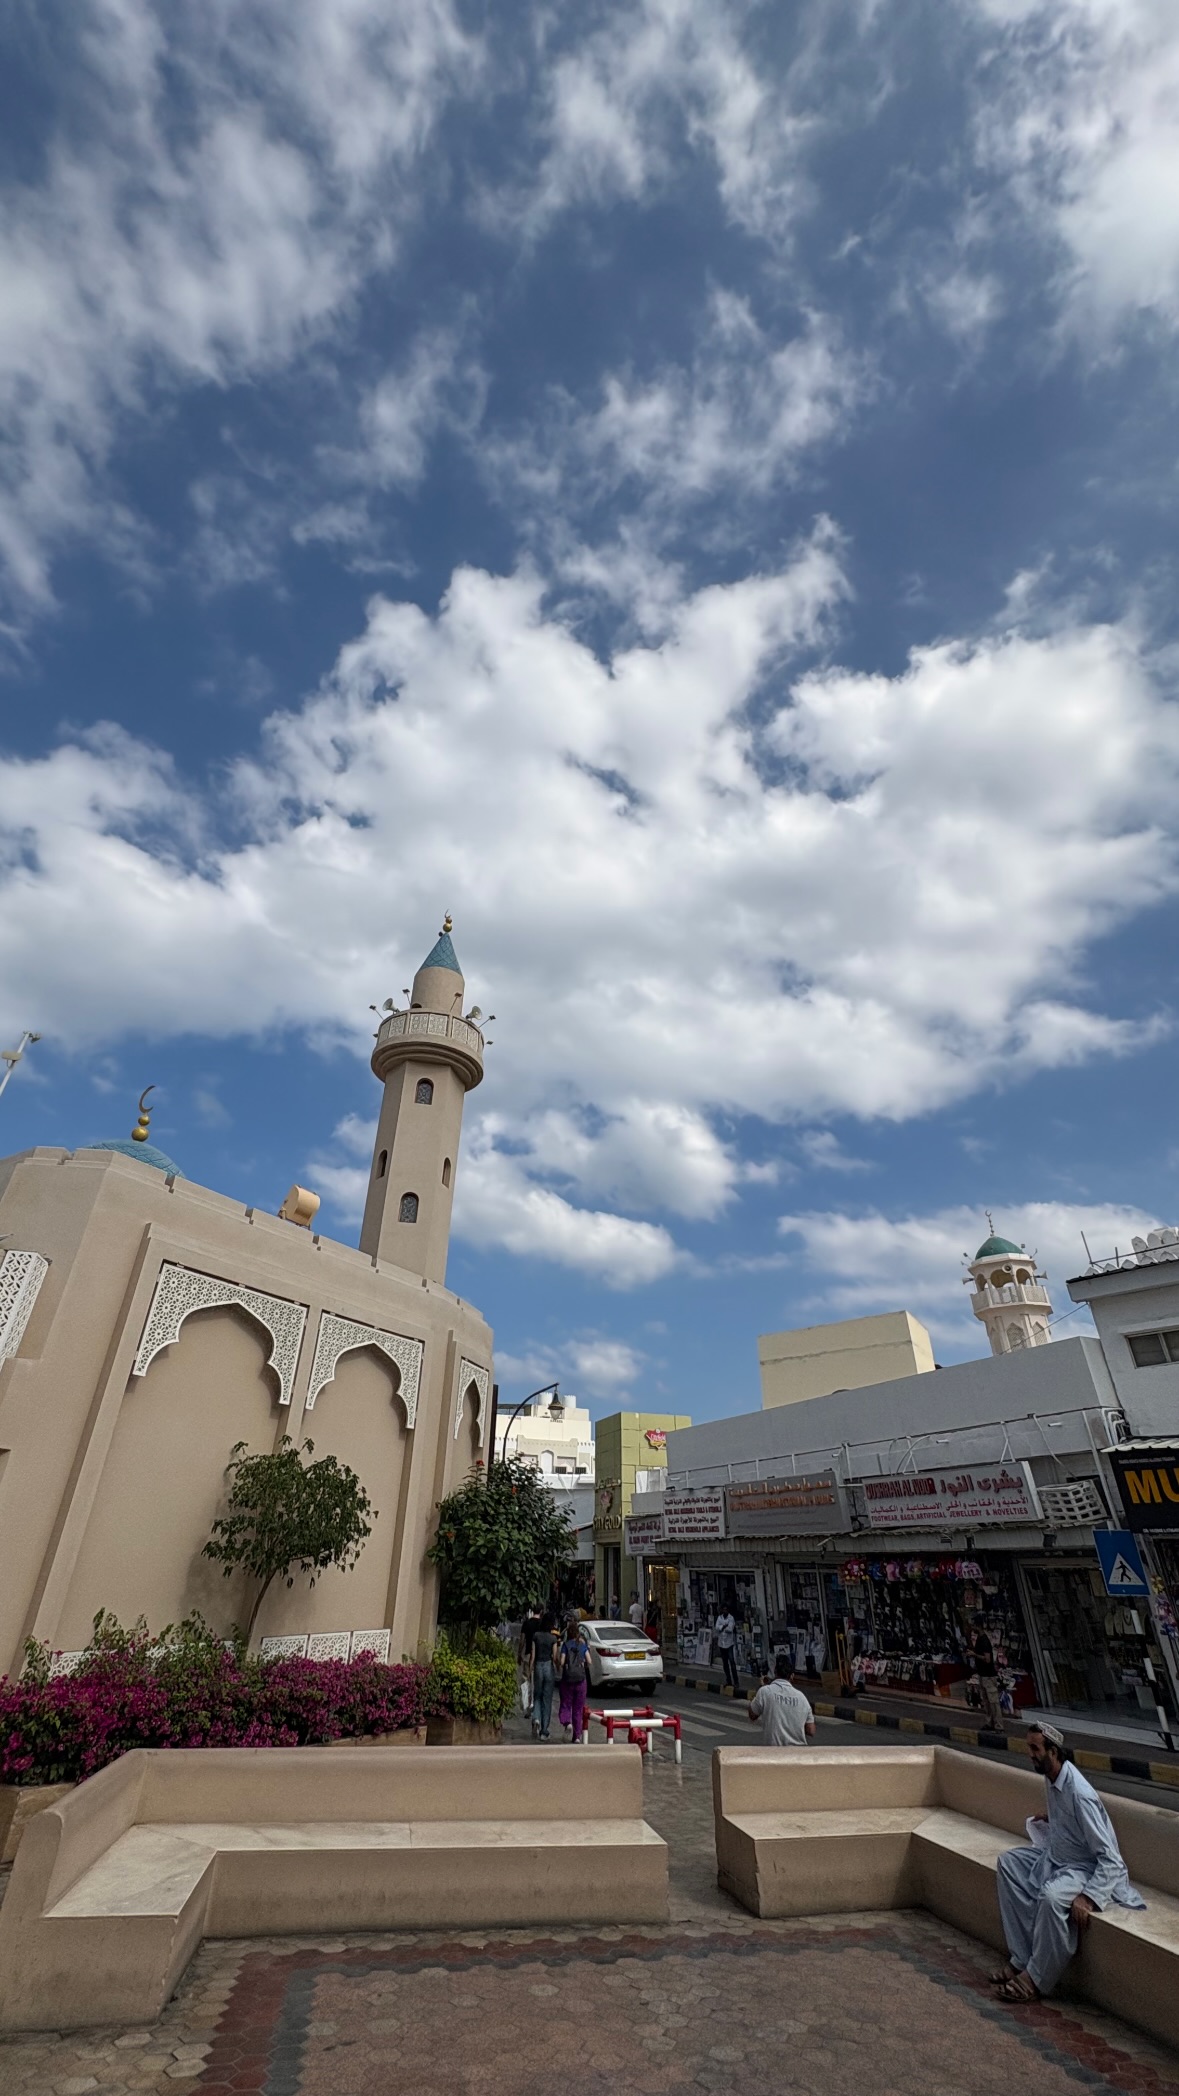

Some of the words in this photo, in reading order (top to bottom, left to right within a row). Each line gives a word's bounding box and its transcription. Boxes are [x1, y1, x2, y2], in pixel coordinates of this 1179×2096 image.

[941, 1474, 975, 1497] النور
[977, 1470, 1024, 1494] بشرى
[916, 1511, 946, 1520] ARTIFICIAL
[949, 1509, 982, 1518] JEWELLERY
[993, 1507, 1029, 1516] NOVELTIES
